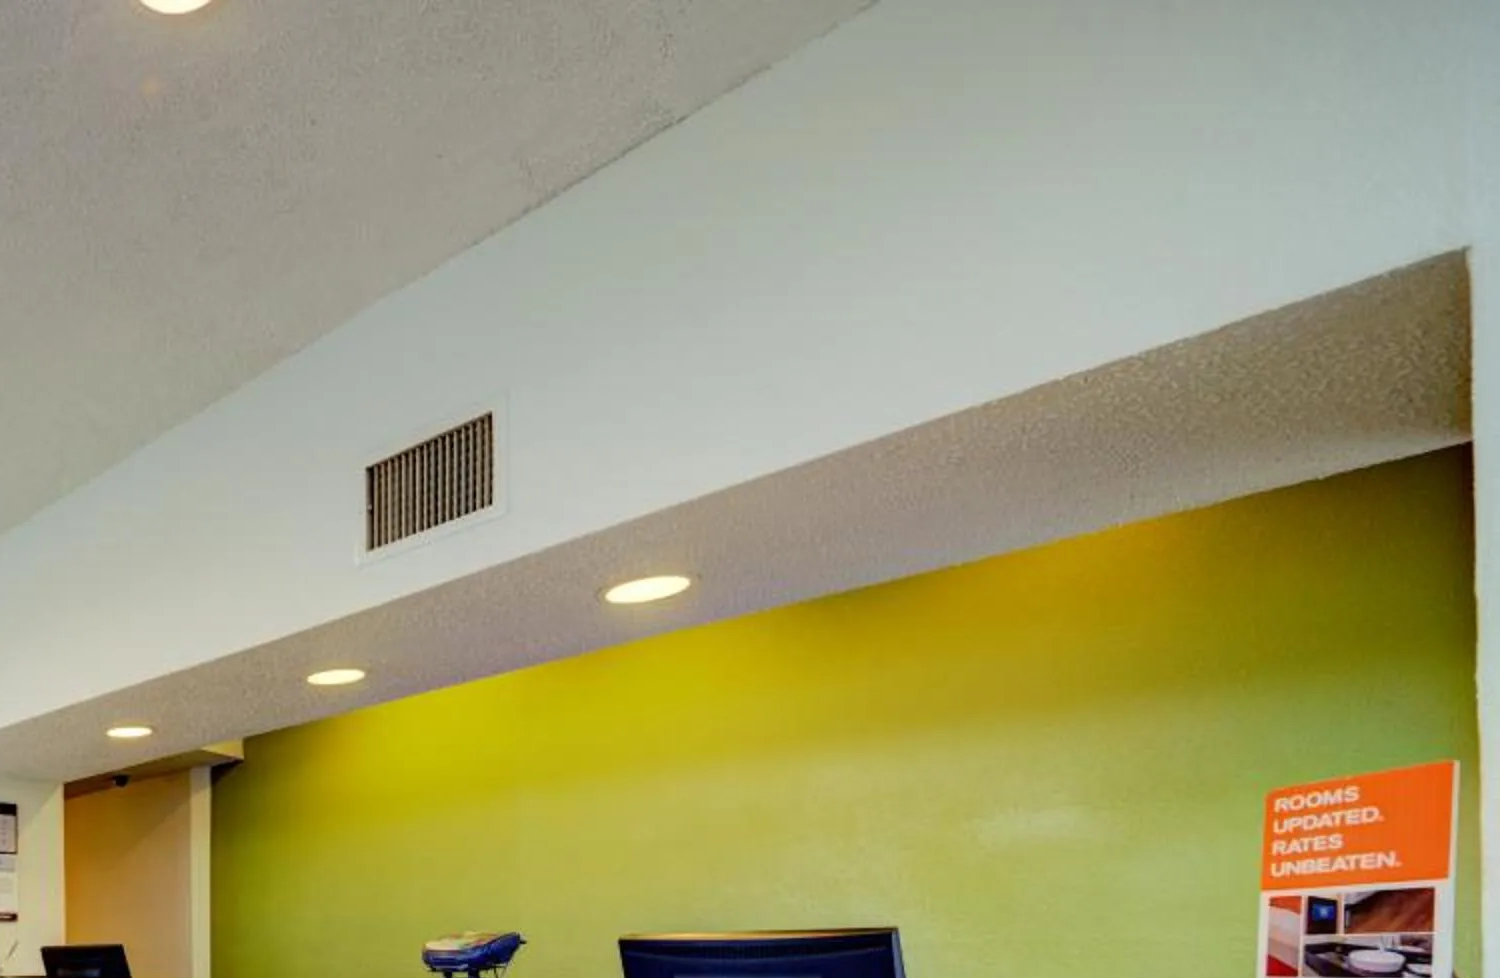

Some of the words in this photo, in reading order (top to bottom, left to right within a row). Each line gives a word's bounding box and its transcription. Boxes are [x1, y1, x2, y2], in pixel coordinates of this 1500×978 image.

[1273, 785, 1361, 813] ROOMS
[1273, 806, 1384, 834] UPDATED.
[1271, 833, 1344, 857] RATES
[1270, 851, 1402, 878] UNBEATEN.
